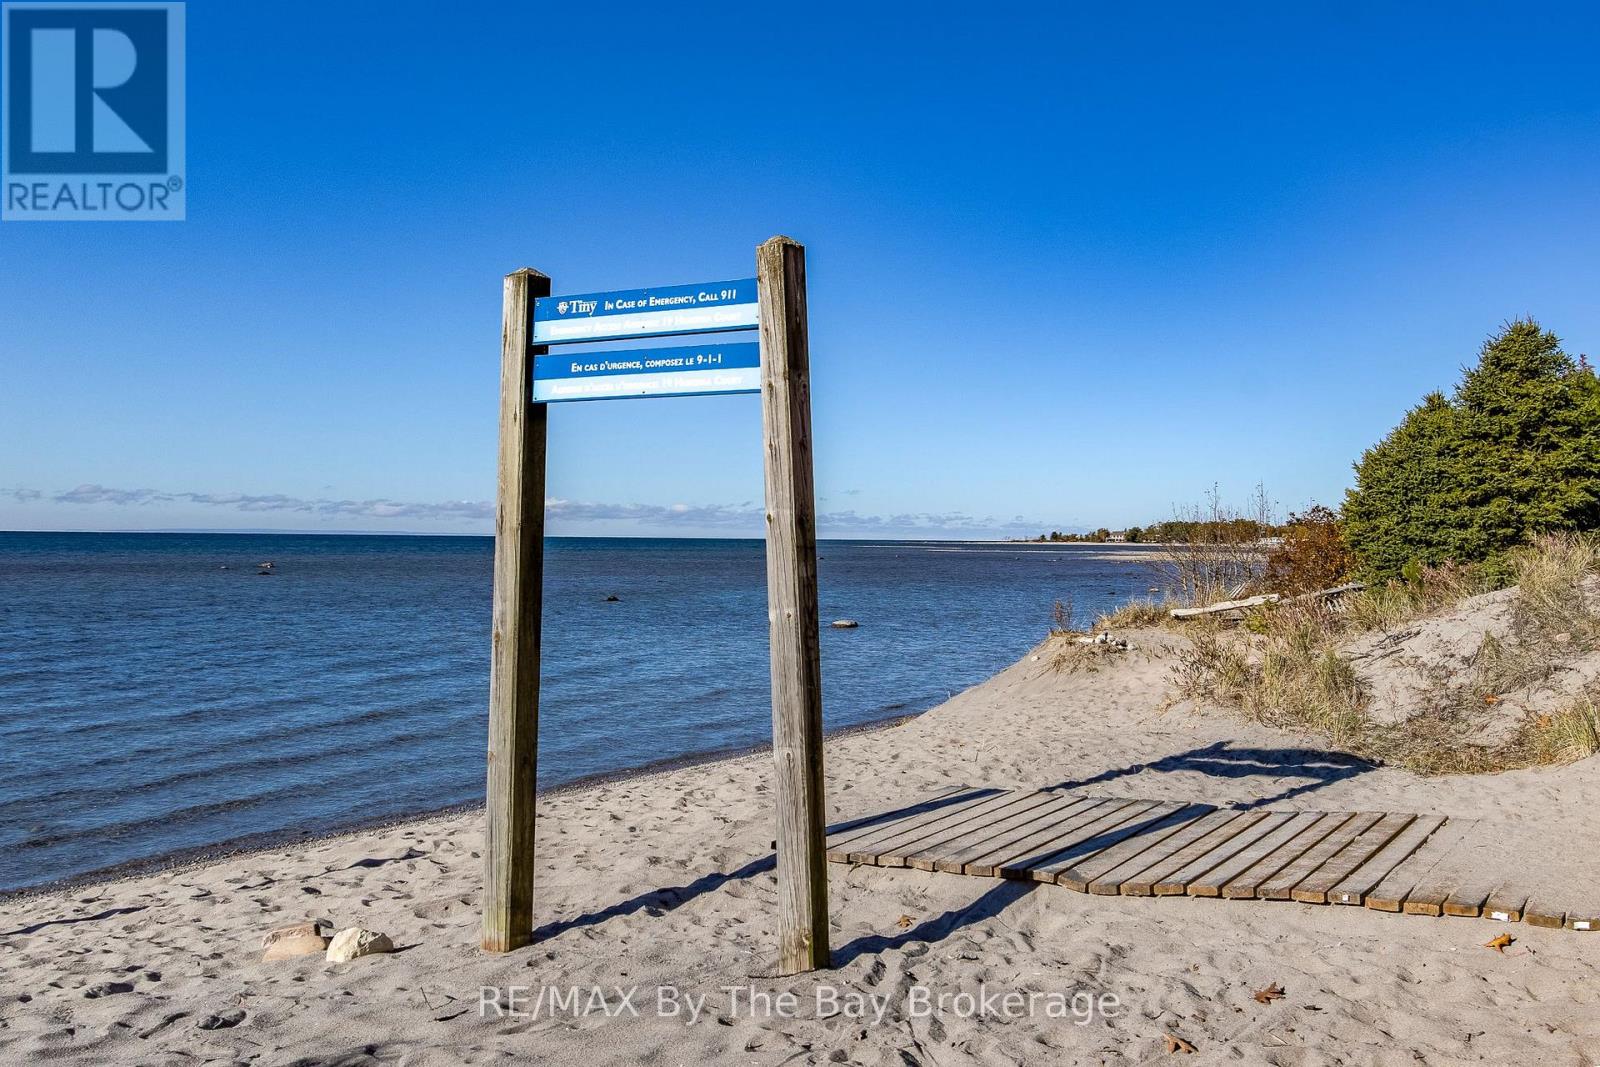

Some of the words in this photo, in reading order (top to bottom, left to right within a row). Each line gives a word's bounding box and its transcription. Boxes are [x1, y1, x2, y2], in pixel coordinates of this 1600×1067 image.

[720, 289, 737, 300] 911
[569, 300, 598, 316] Tiny
[696, 353, 722, 365] 9-1-1
